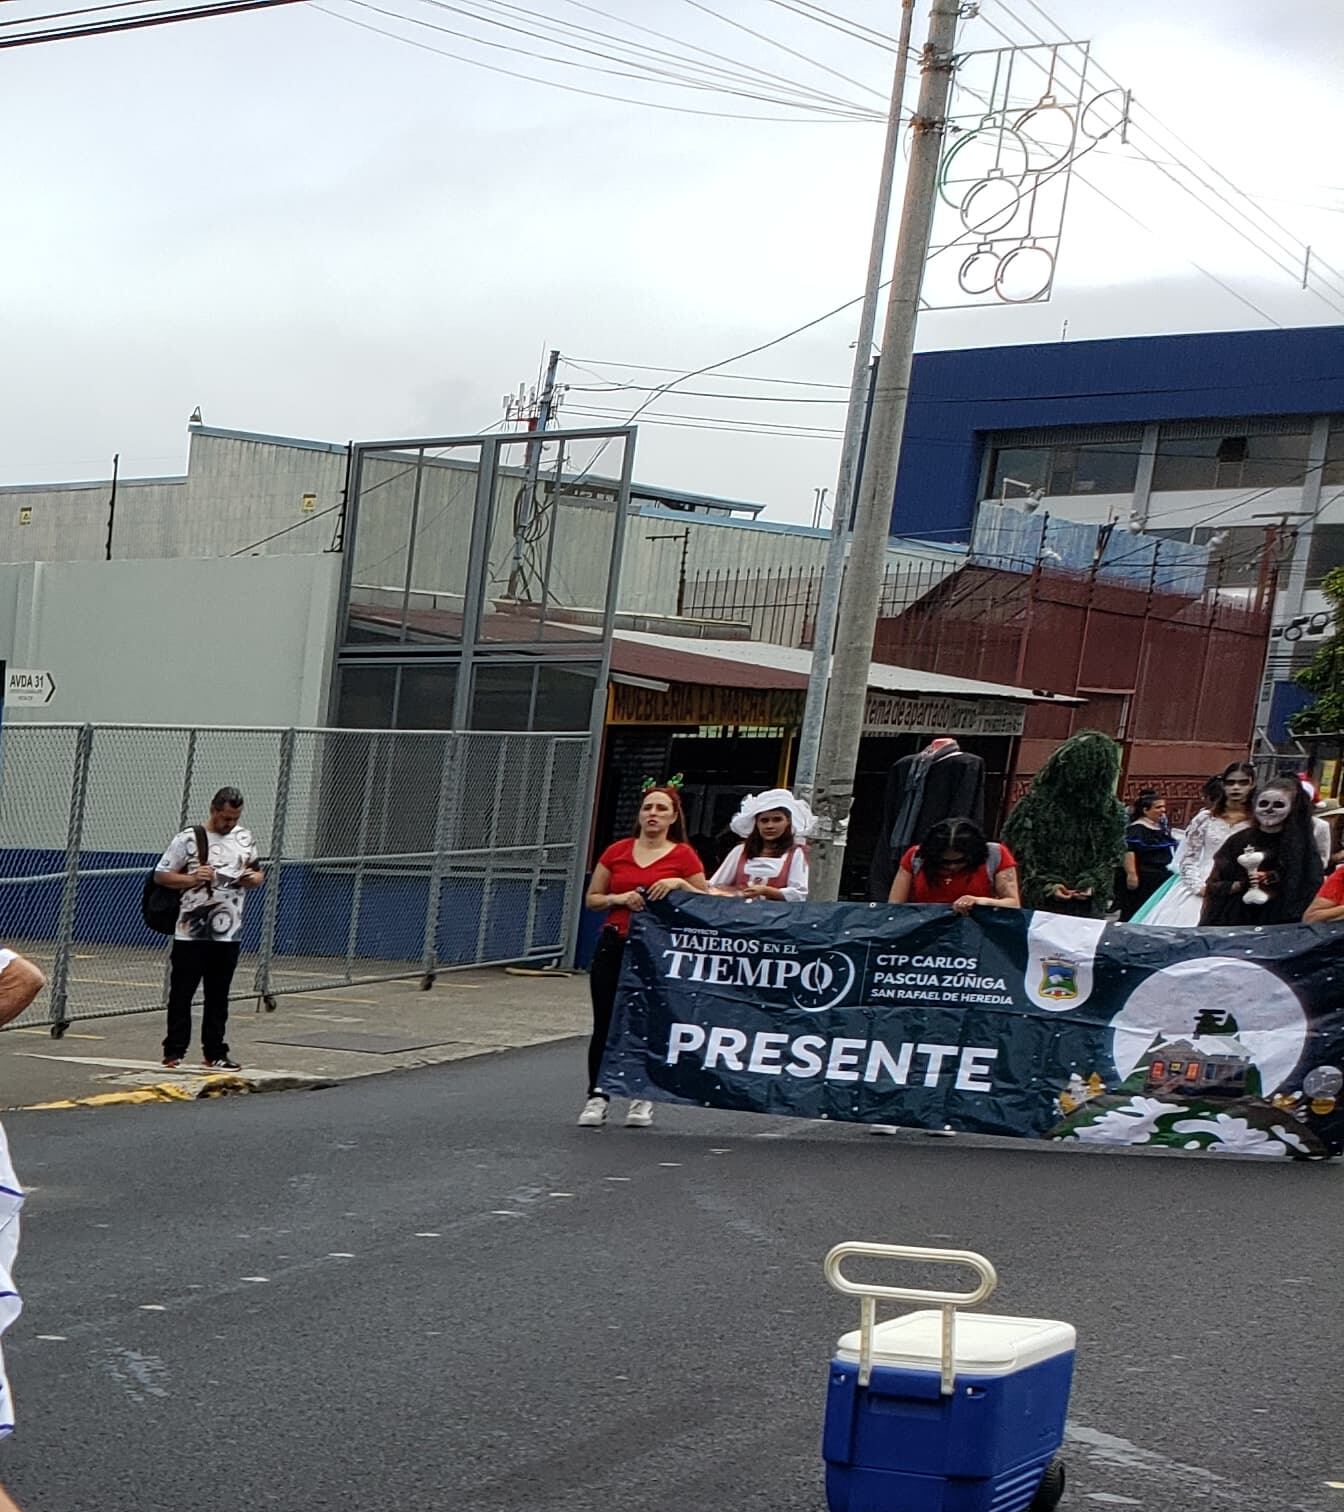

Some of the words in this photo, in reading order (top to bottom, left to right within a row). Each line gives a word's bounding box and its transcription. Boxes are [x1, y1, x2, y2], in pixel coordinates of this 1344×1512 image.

[9, 674, 33, 688] AVDA
[35, 675, 43, 688] 31
[670, 933, 760, 954] VIAJEROS
[762, 943, 780, 953] EN
[782, 944, 799, 954] EL
[876, 954, 910, 966] CTP
[912, 956, 978, 969] CARLOS
[662, 950, 833, 992] TIEMPO
[874, 972, 939, 986] PASCUA
[941, 972, 1007, 990] ZÚÑIGA
[871, 988, 896, 998] SAN
[897, 989, 940, 1000] RAFAEL
[942, 992, 959, 1002] DE
[961, 993, 1013, 1005] HEREDIA
[666, 1022, 999, 1092] PRESENTE
